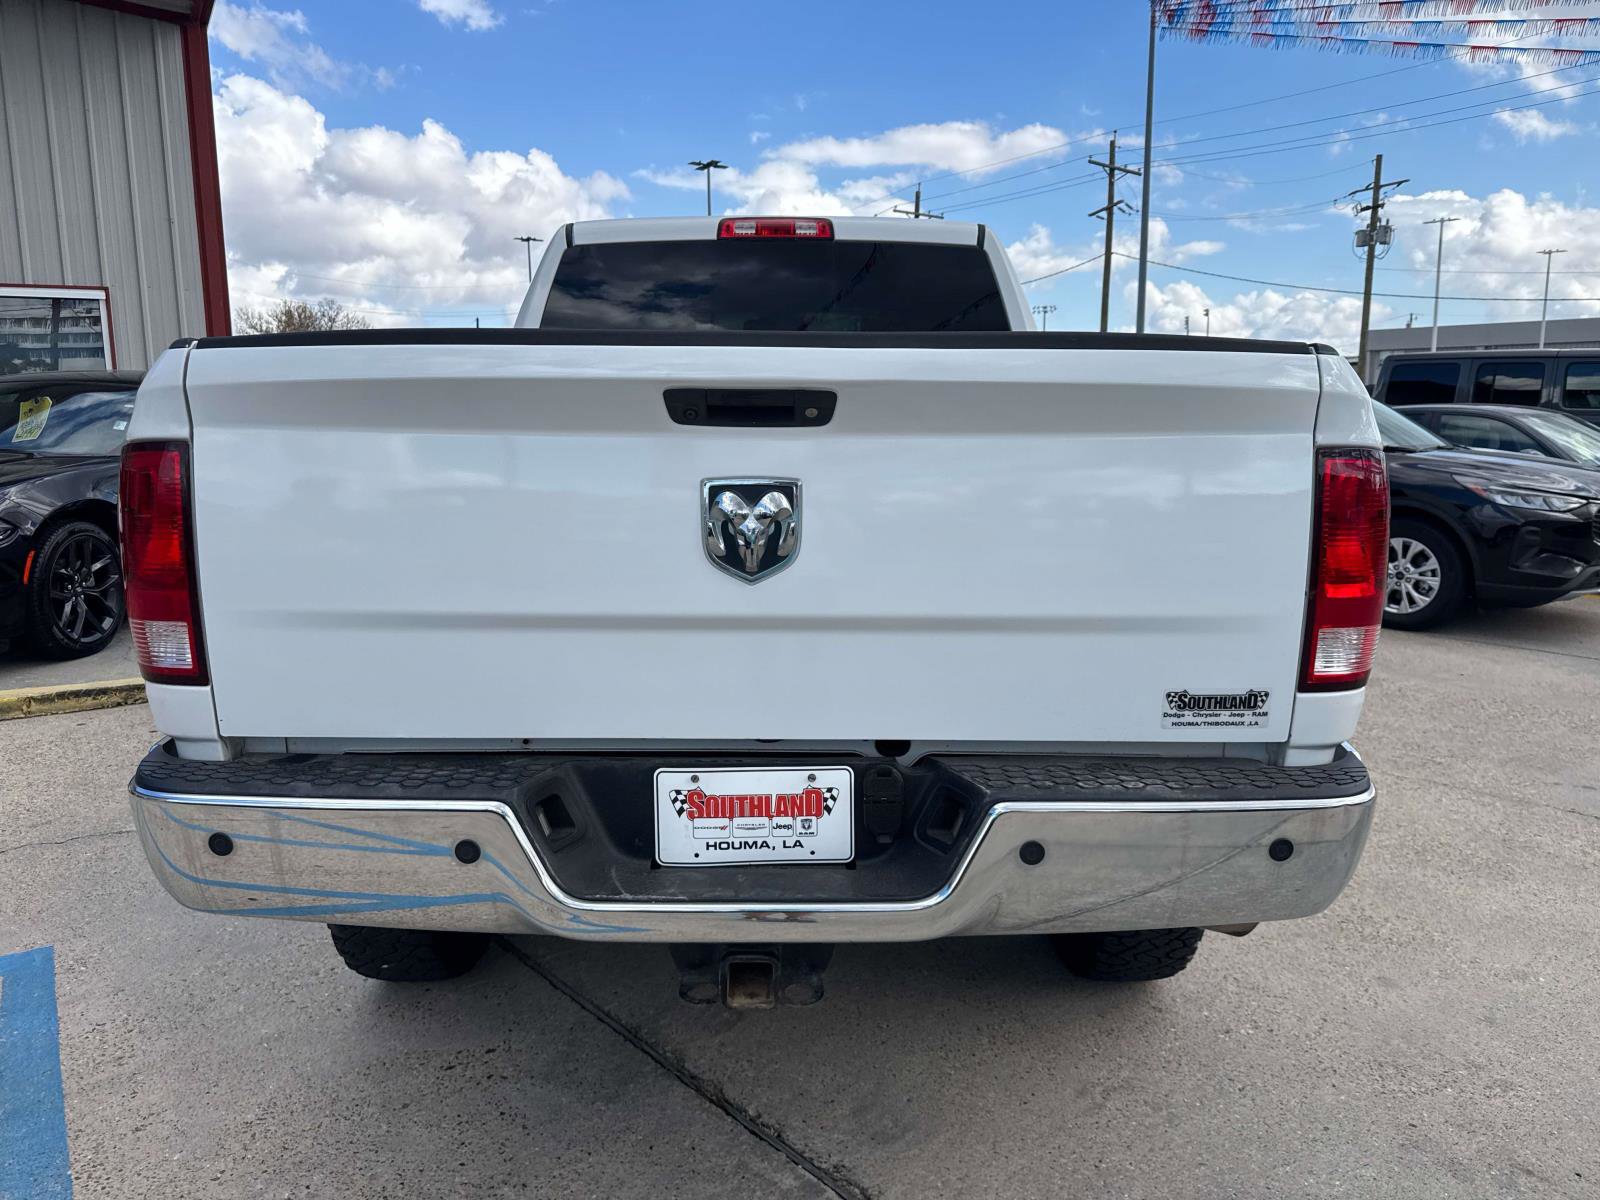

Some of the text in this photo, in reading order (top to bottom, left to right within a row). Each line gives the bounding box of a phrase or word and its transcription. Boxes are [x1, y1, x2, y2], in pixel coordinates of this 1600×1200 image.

[1177, 693, 1259, 710] SOUTHLAND
[686, 788, 824, 819] SOUTHLAND
[773, 822, 793, 831] Jeep
[706, 839, 804, 851] HOUMA, LA
